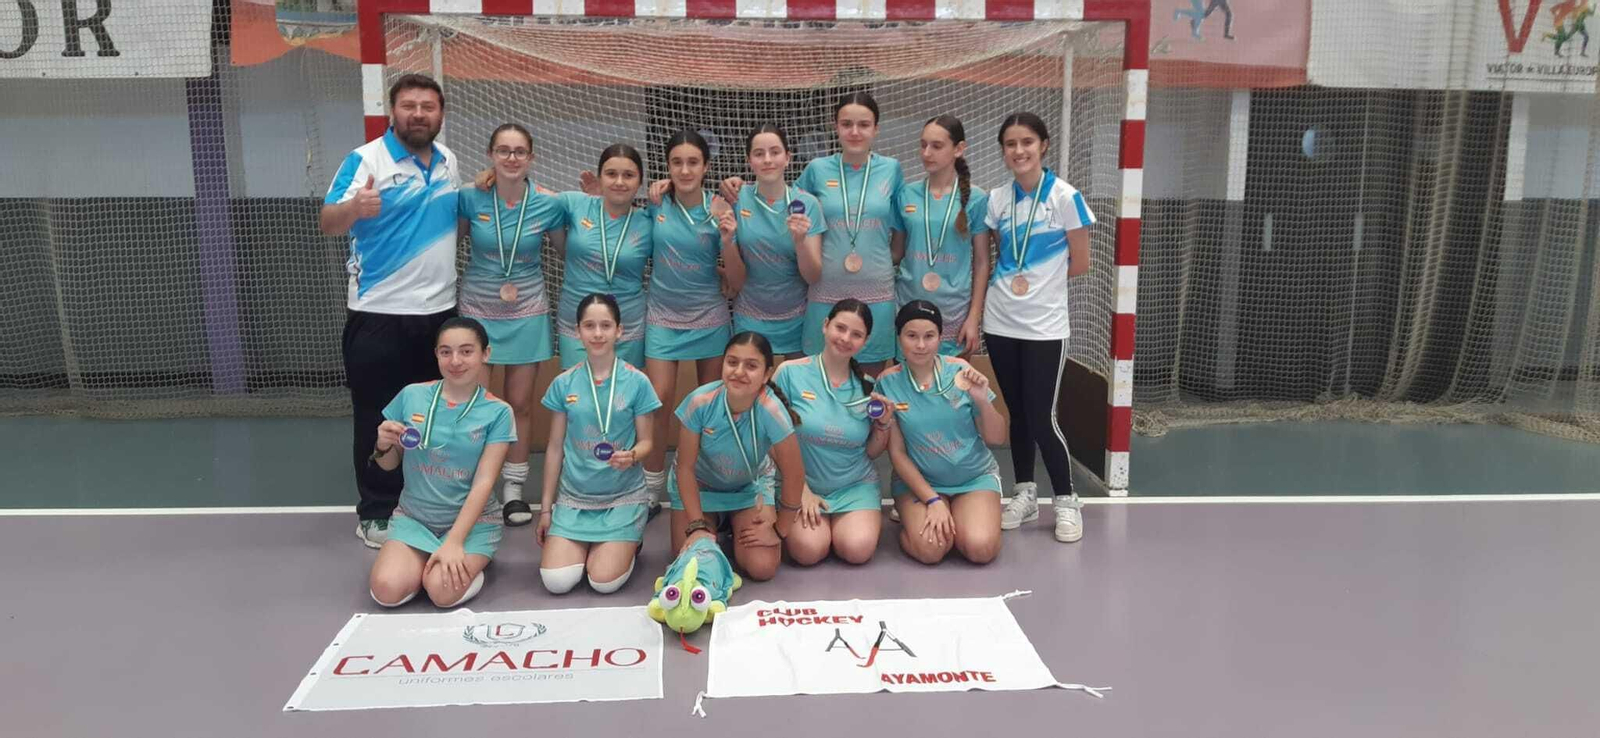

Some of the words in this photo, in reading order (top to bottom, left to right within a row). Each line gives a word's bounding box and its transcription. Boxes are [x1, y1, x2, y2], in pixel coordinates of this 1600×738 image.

[757, 608, 817, 617] CLUB
[758, 615, 863, 627] HOCKEY
[333, 648, 647, 676] CAMACHO
[398, 675, 484, 685] uniformes
[490, 673, 574, 682] escolares
[881, 670, 997, 685] AYAMONTE
